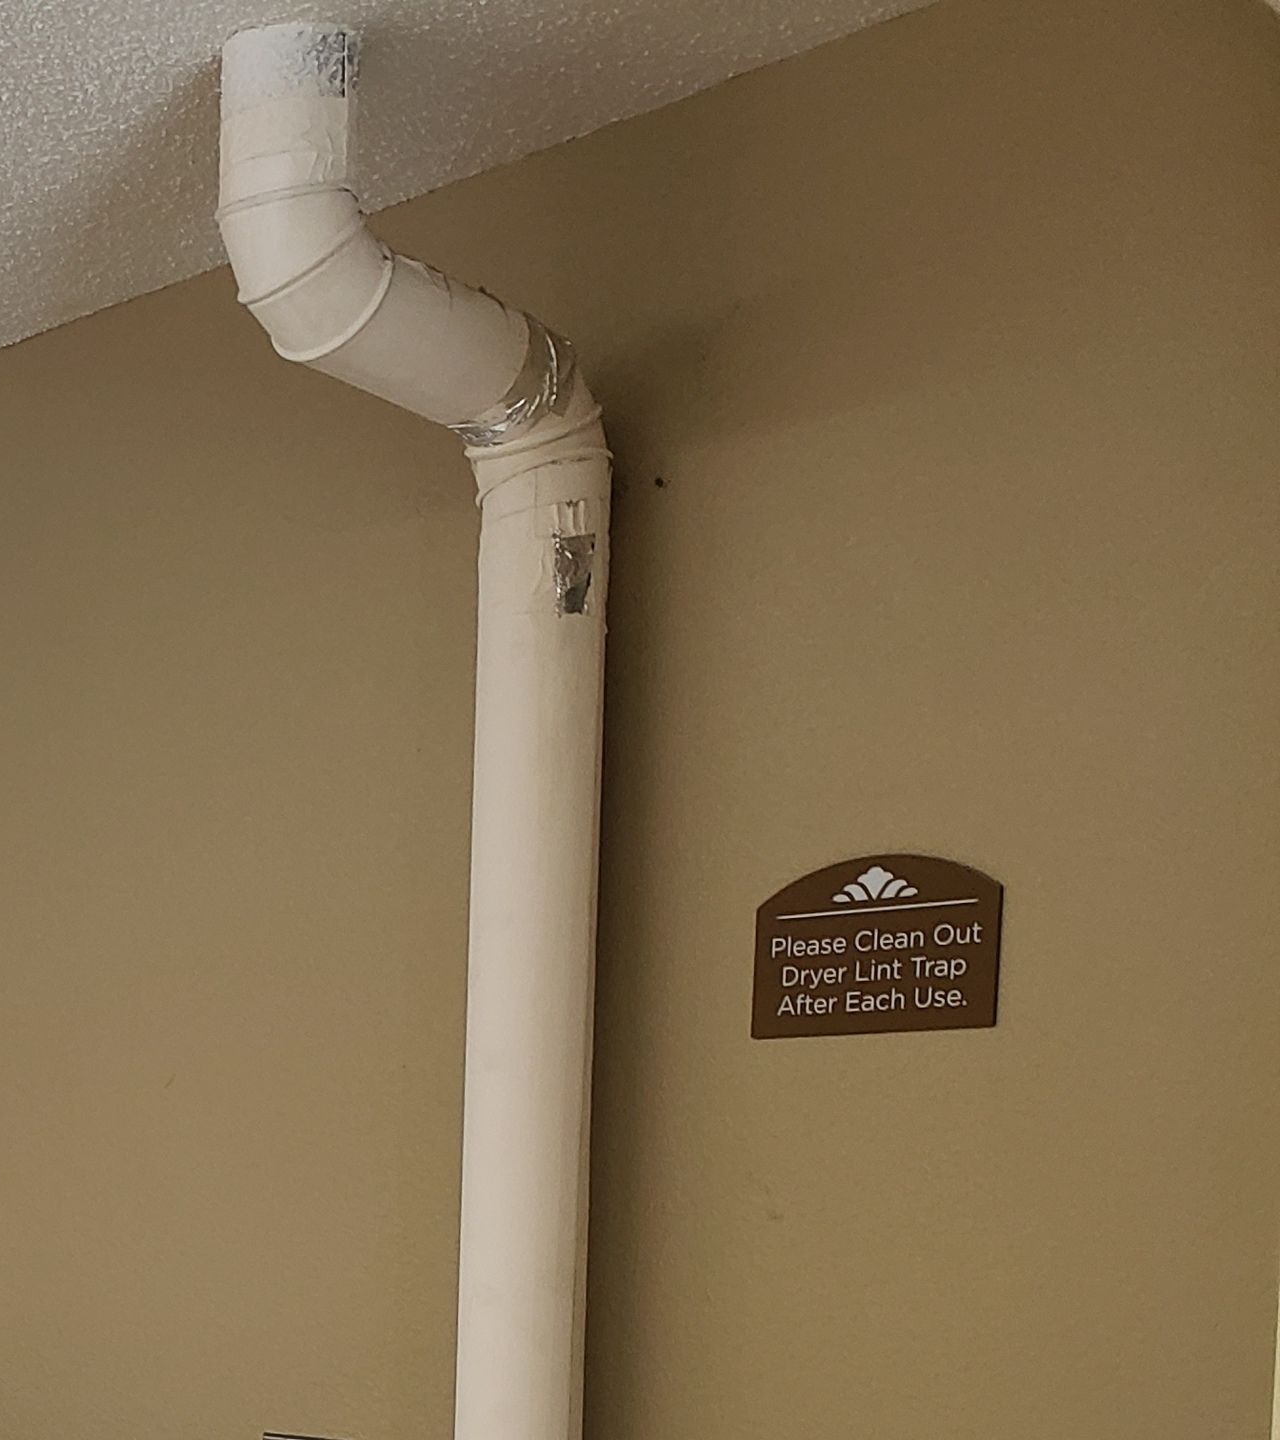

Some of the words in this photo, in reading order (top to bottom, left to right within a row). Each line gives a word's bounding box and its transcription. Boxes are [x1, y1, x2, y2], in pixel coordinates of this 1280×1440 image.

[771, 936, 847, 959] Please
[855, 929, 924, 951] Clean
[934, 922, 983, 945] Out
[782, 966, 847, 989] Dryer
[855, 960, 902, 982] Lint
[911, 957, 966, 980] Trap
[777, 994, 837, 1017] After
[846, 988, 905, 1012] Each
[915, 987, 967, 1008] Use.
